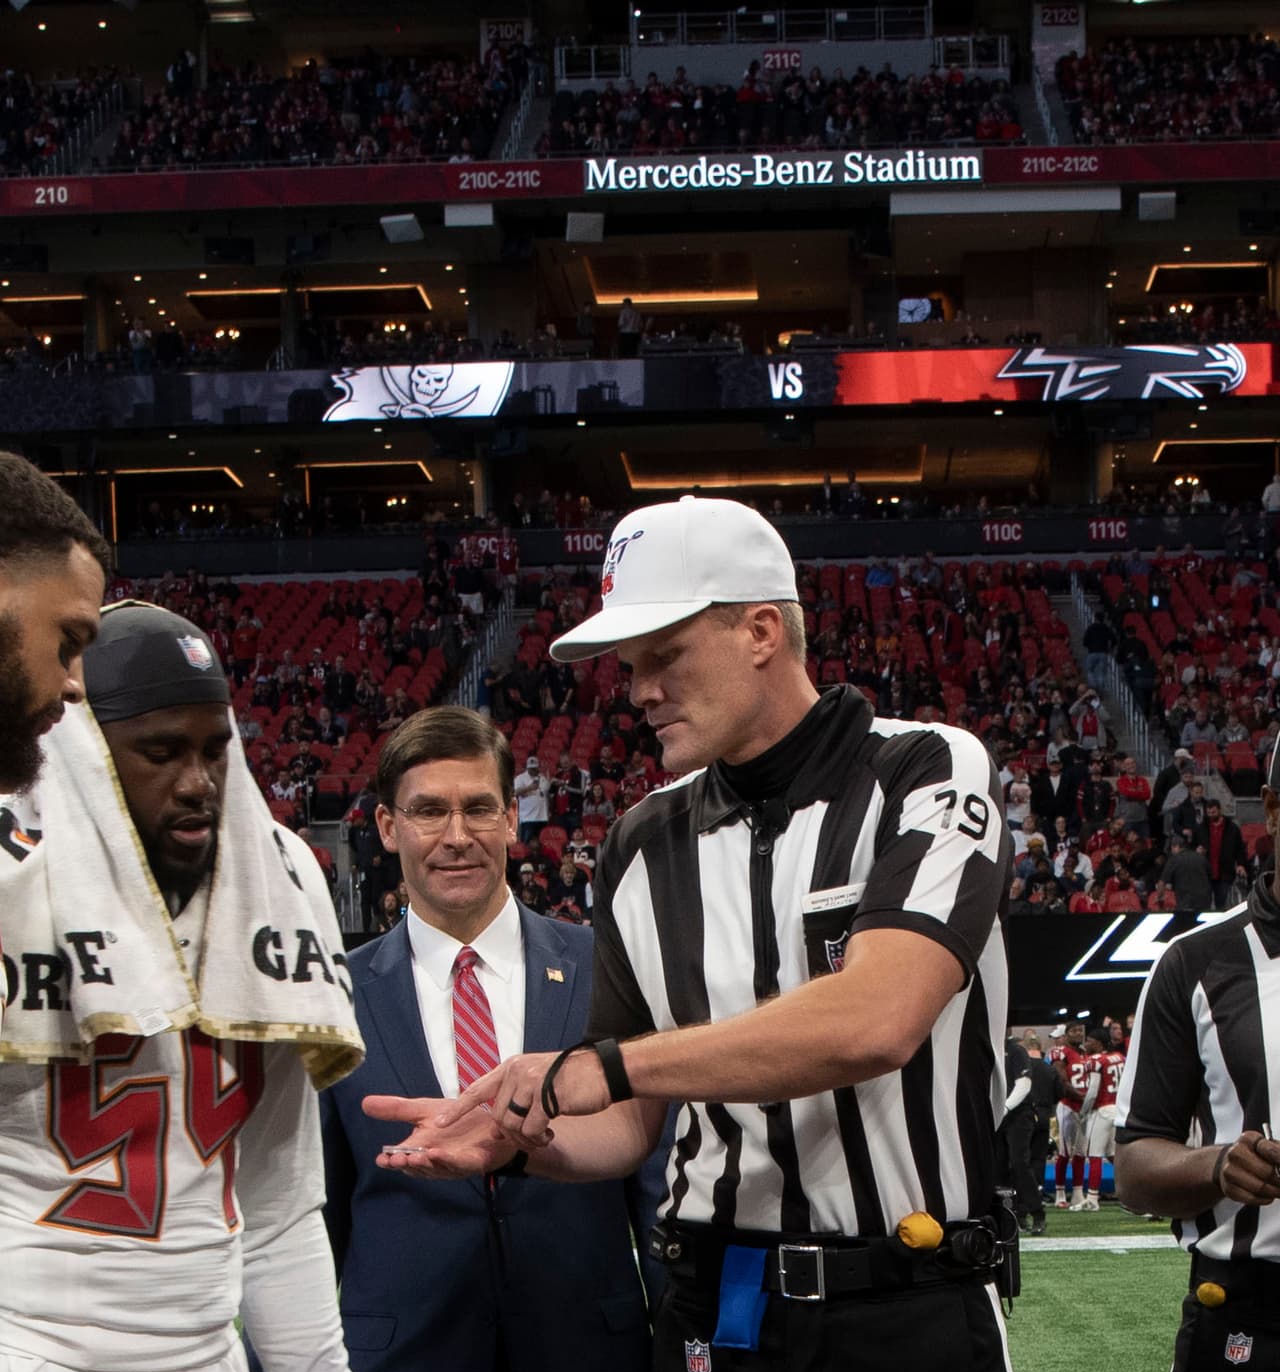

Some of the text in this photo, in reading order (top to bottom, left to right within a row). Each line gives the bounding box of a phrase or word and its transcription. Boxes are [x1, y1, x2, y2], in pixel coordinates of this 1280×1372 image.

[1041, 7, 1079, 25] 212C
[764, 52, 801, 70] 211C
[585, 150, 982, 191] Mercedes-Benz Stadium
[1021, 155, 1099, 174] 211C-212C
[458, 169, 541, 190] 210C-211C
[34, 185, 69, 206] 210
[767, 361, 804, 400] VS
[982, 522, 1022, 541] 110C
[1088, 520, 1127, 540] 111C
[459, 536, 498, 554] 19C
[564, 533, 604, 552] 110C
[934, 789, 990, 841] 79
[688, 1356, 709, 1372] NFL
